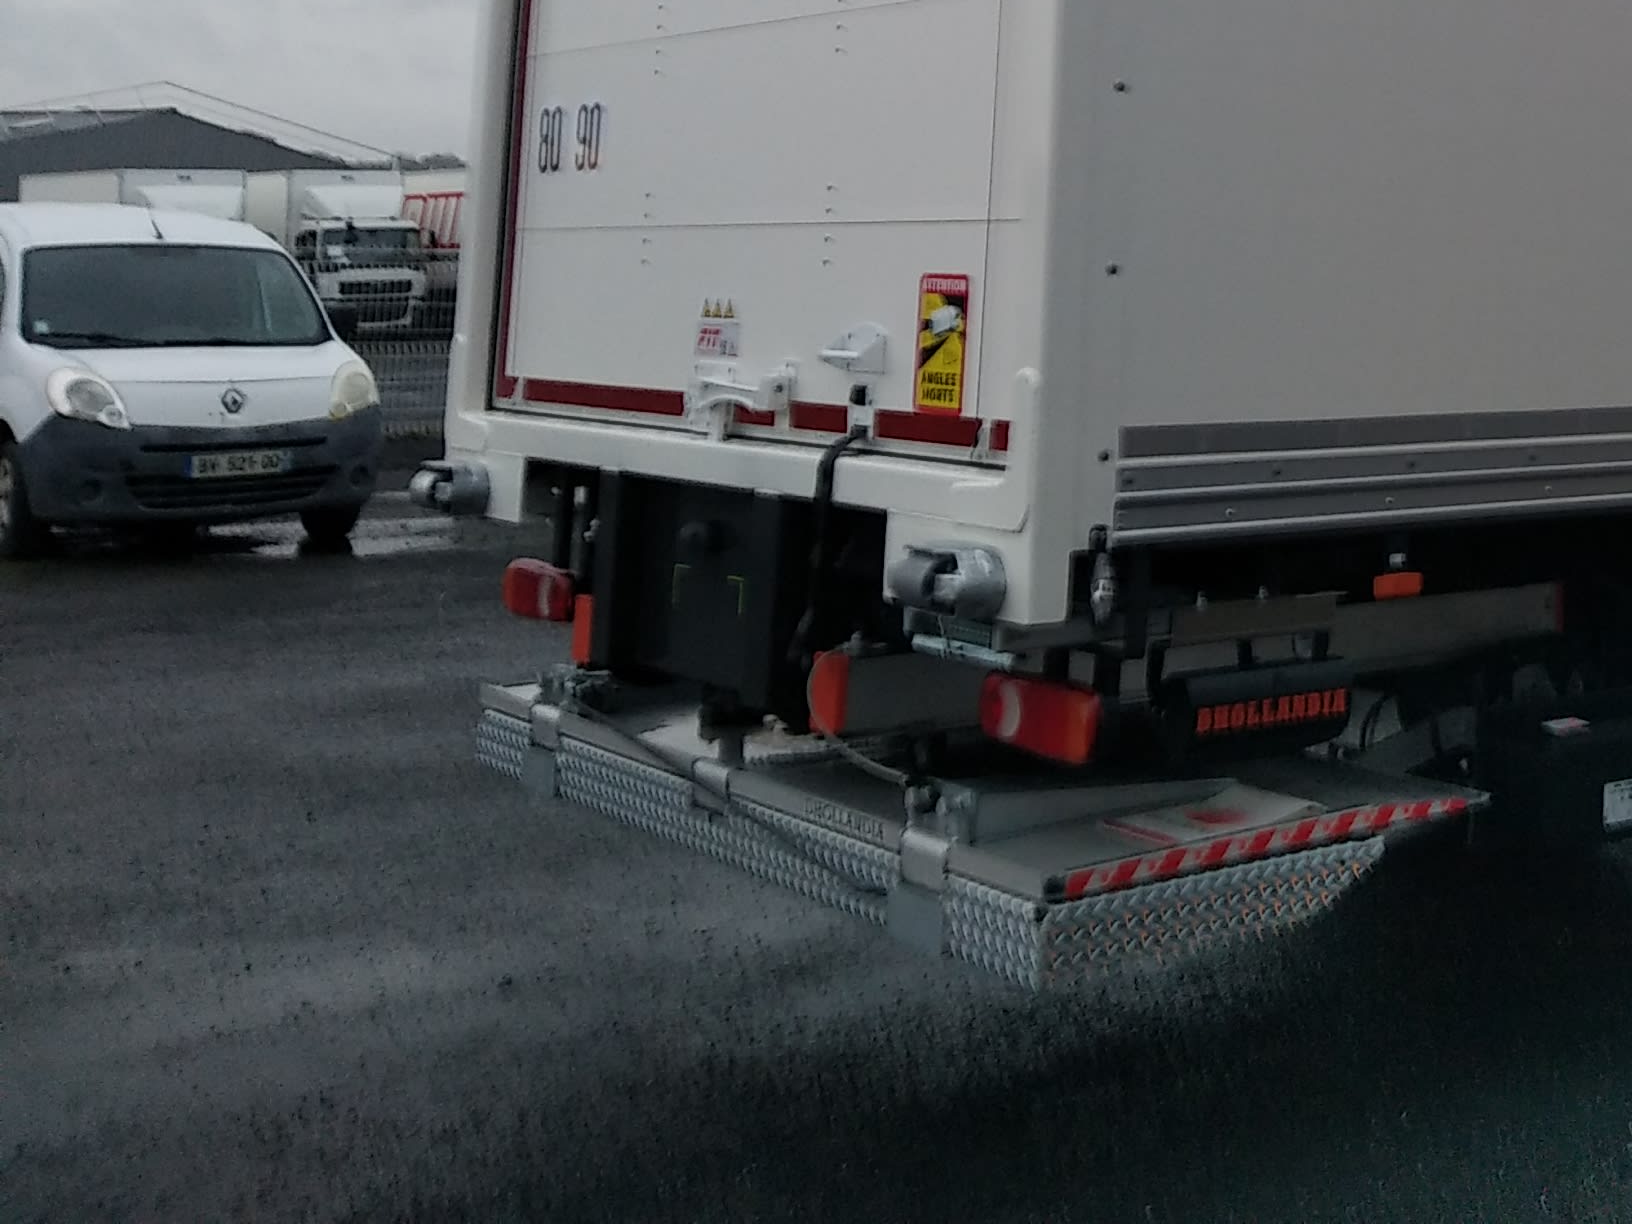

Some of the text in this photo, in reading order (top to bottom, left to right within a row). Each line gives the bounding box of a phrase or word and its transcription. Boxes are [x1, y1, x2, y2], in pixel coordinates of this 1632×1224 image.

[539, 102, 601, 173] 80 90
[1196, 688, 1346, 734] DHOLLANDIA
